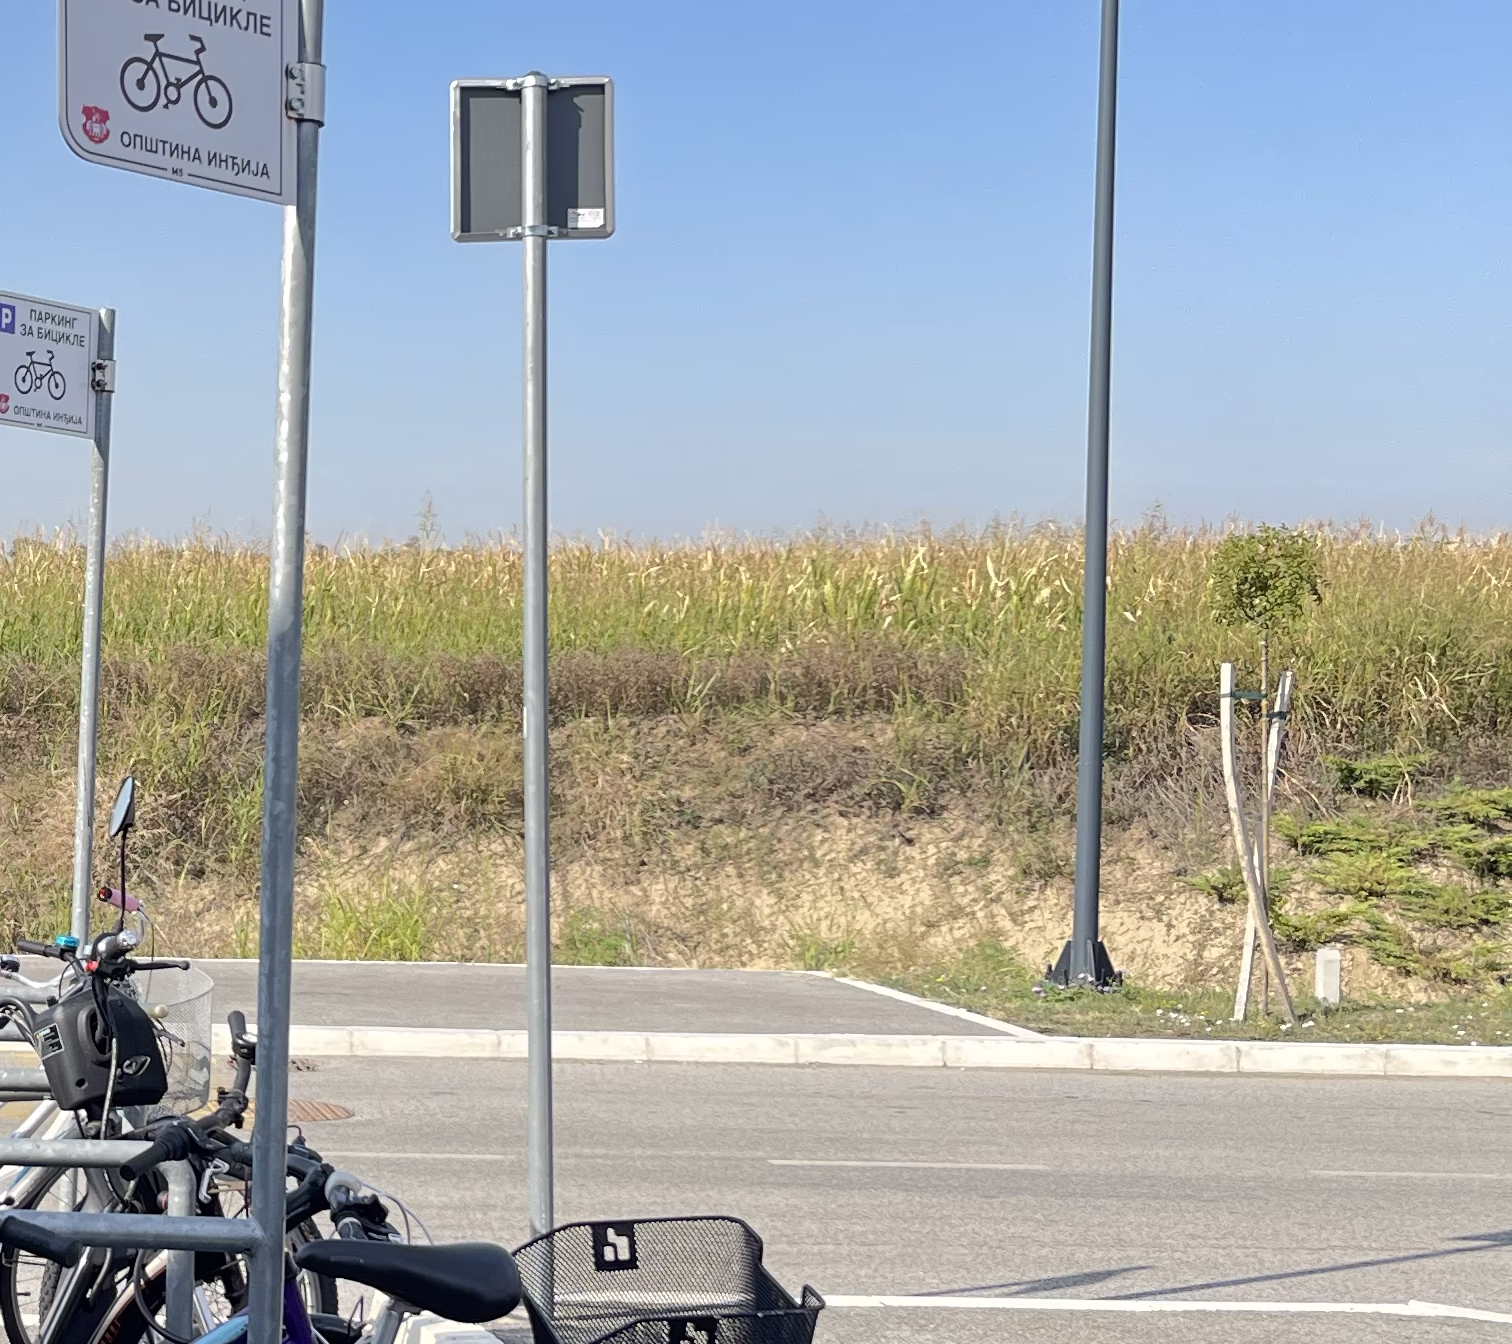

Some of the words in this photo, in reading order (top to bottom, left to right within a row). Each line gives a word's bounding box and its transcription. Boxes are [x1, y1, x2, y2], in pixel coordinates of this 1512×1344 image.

[120, 131, 202, 164] ОПШТИНА
[207, 150, 270, 179] ИНЂИЈА
[1, 307, 13, 329] P
[29, 309, 78, 329] ПАРКИНГ
[20, 323, 34, 338] ЗА
[37, 327, 86, 347] БИЦИКЛЕ
[13, 405, 51, 421] ОПШТИНА
